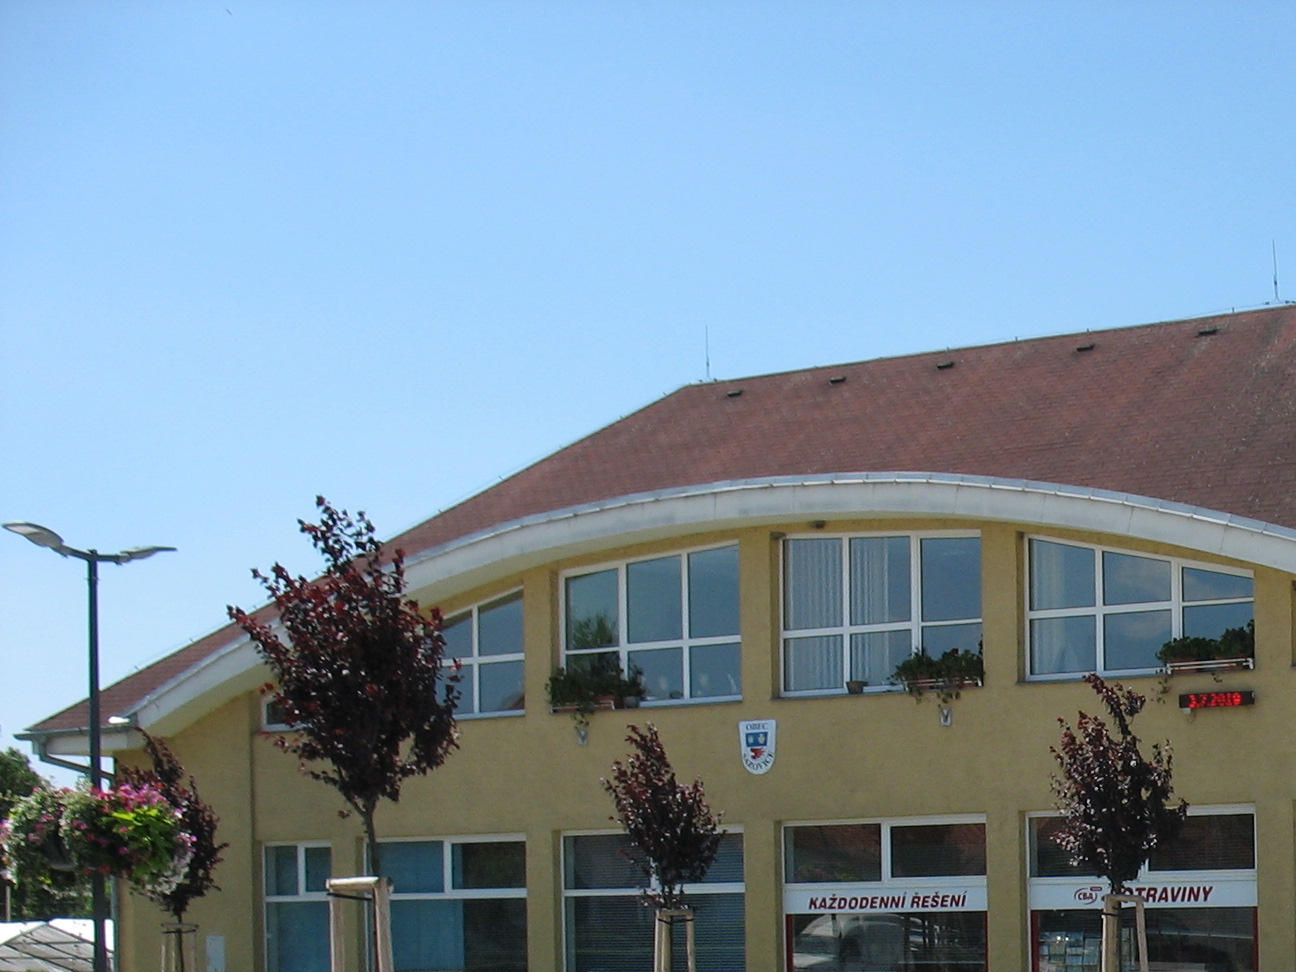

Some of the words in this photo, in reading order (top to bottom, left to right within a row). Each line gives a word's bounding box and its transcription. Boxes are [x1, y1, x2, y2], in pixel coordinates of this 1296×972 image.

[809, 891, 907, 910] KAŽDODENNÍ
[911, 890, 967, 909] ŘEŠENÍ
[1077, 892, 1094, 900] CBA
[1110, 886, 1213, 903] OTRAVINY
